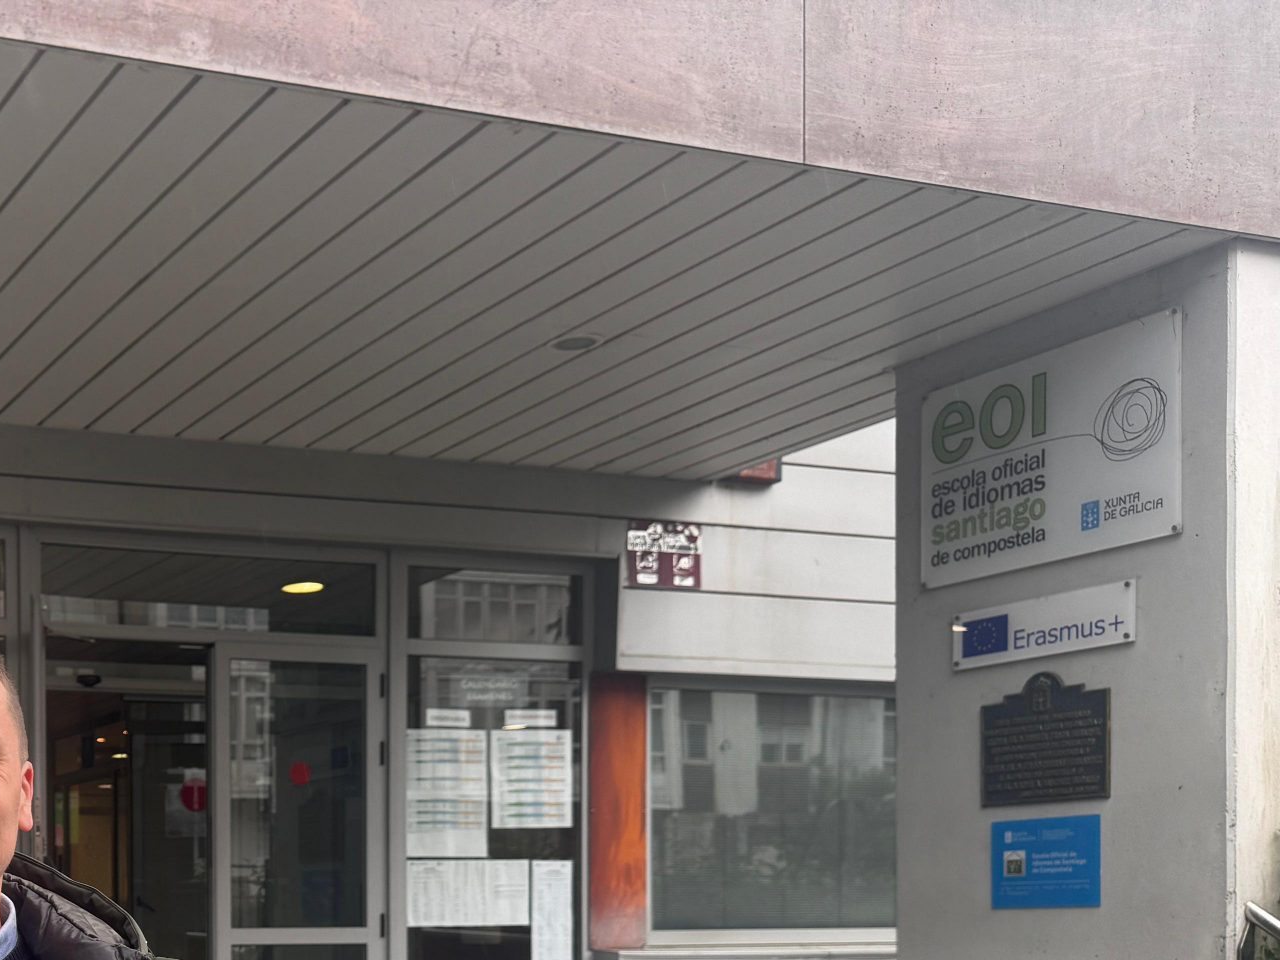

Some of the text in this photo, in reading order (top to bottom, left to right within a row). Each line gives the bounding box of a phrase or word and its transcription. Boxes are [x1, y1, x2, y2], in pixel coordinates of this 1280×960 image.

[931, 448, 1045, 498] escola oficial
[931, 474, 1046, 519] de idiomas
[1104, 491, 1140, 510] XUNTA
[1104, 498, 1163, 521] DE GALICIA
[931, 497, 1046, 546] santiago
[931, 526, 1046, 567] de compostela
[1013, 614, 1125, 650] Erasmus+
